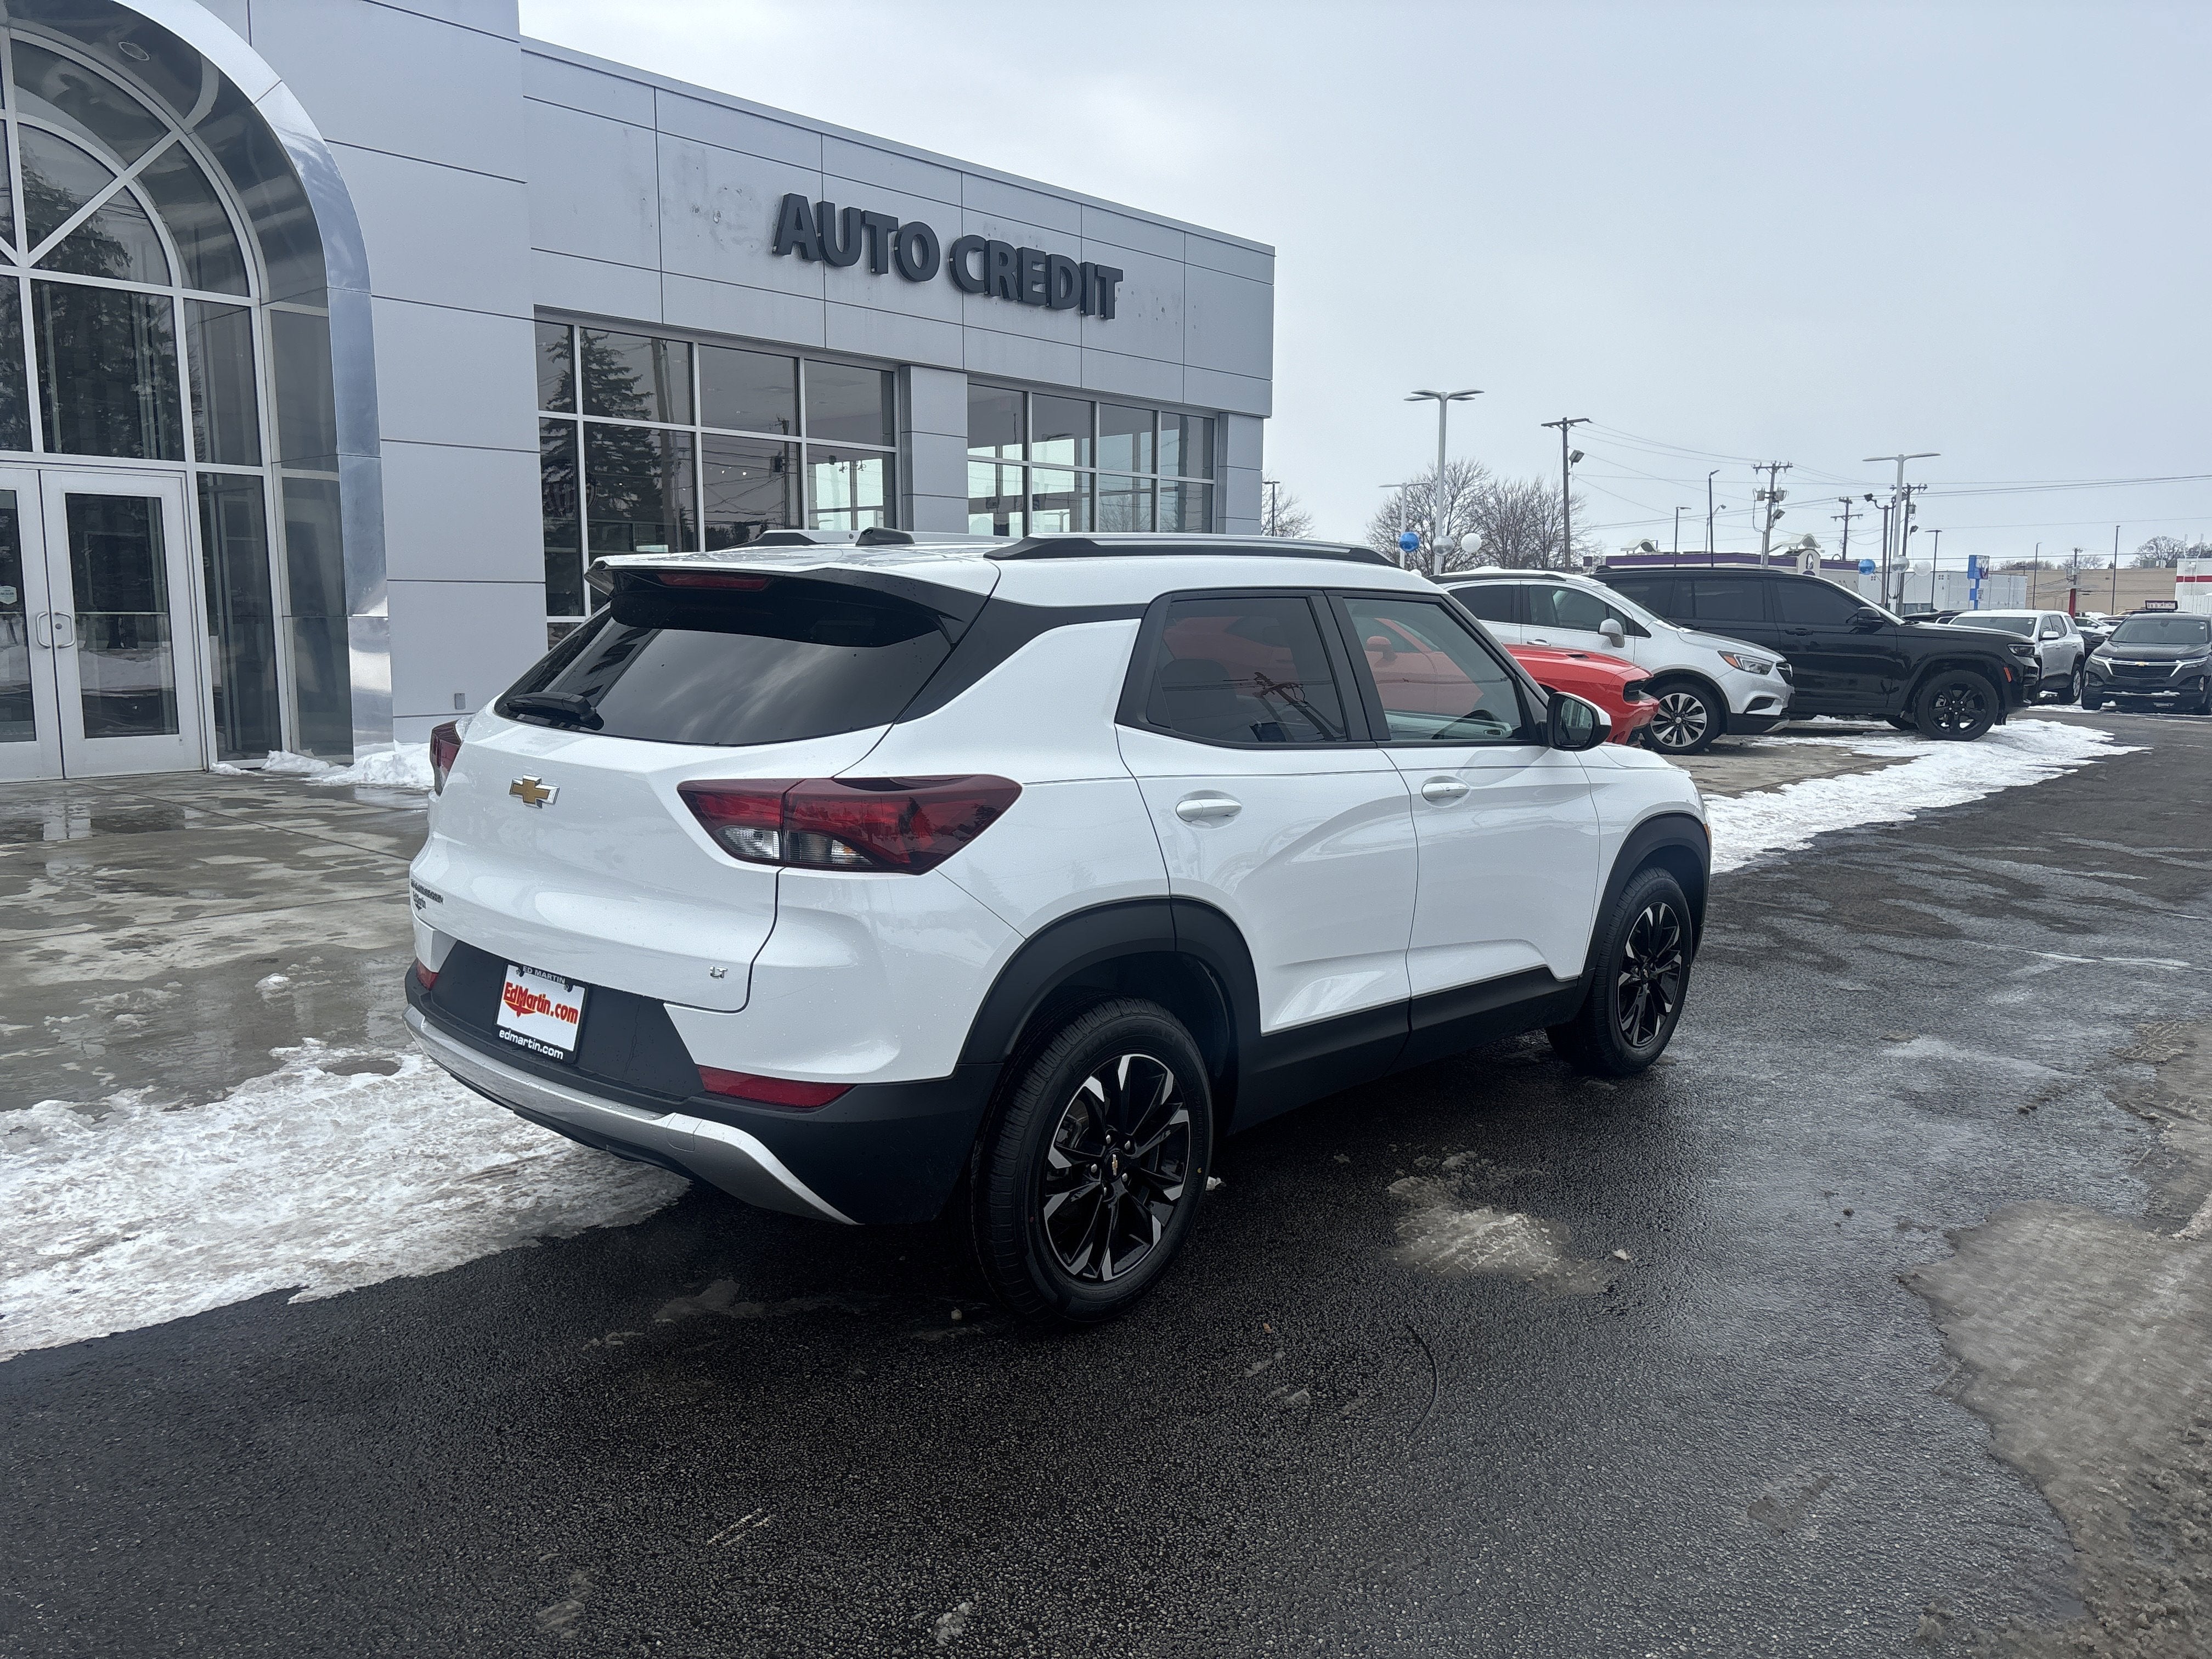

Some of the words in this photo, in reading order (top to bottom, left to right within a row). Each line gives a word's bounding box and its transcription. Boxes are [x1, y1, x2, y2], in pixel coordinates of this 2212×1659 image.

[773, 193, 940, 282] AUTO
[949, 234, 1124, 319] CREDIT
[522, 966, 533, 974] ED
[534, 969, 566, 984] MARTIN
[710, 966, 728, 979] LT
[503, 981, 579, 1024] EdMartin.com
[499, 1029, 563, 1060] edmartin.com
